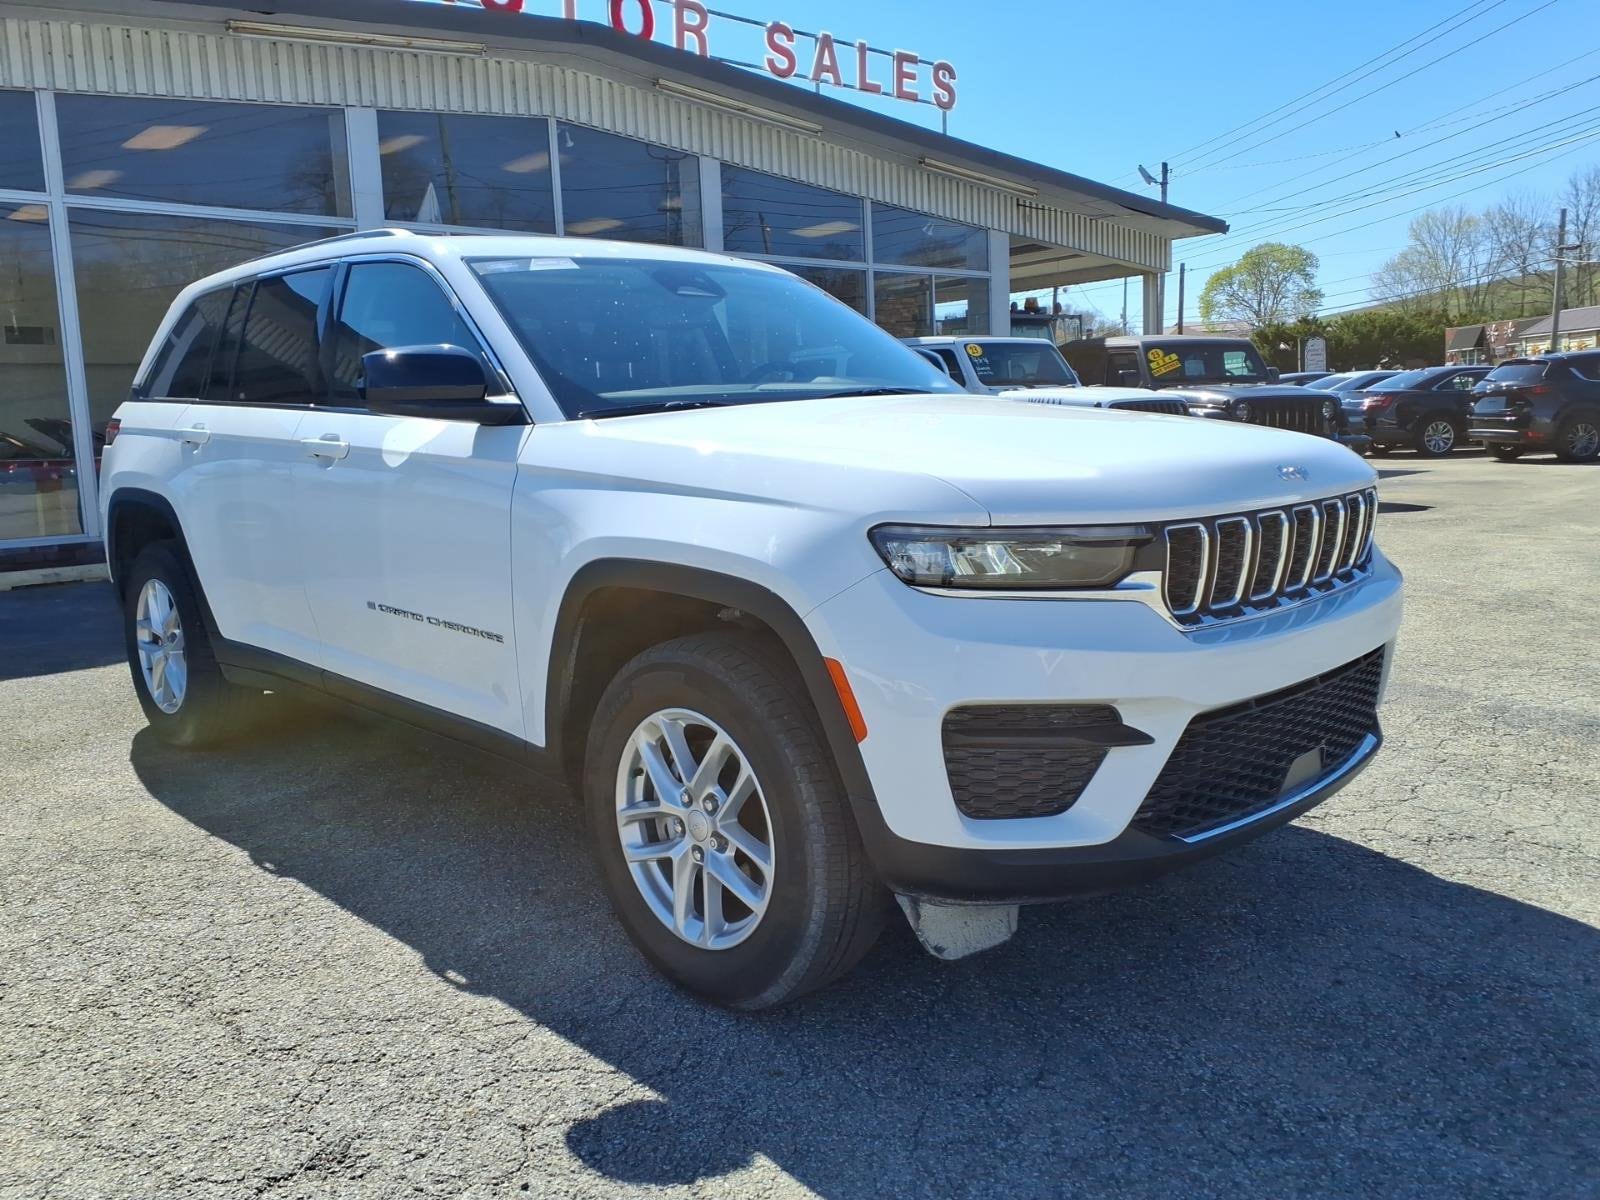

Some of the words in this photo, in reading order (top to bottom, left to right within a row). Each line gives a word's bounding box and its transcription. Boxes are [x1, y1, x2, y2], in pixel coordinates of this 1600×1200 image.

[766, 21, 957, 111] SALES
[378, 603, 423, 623] GRAND
[426, 616, 504, 644] CHEROKEE
